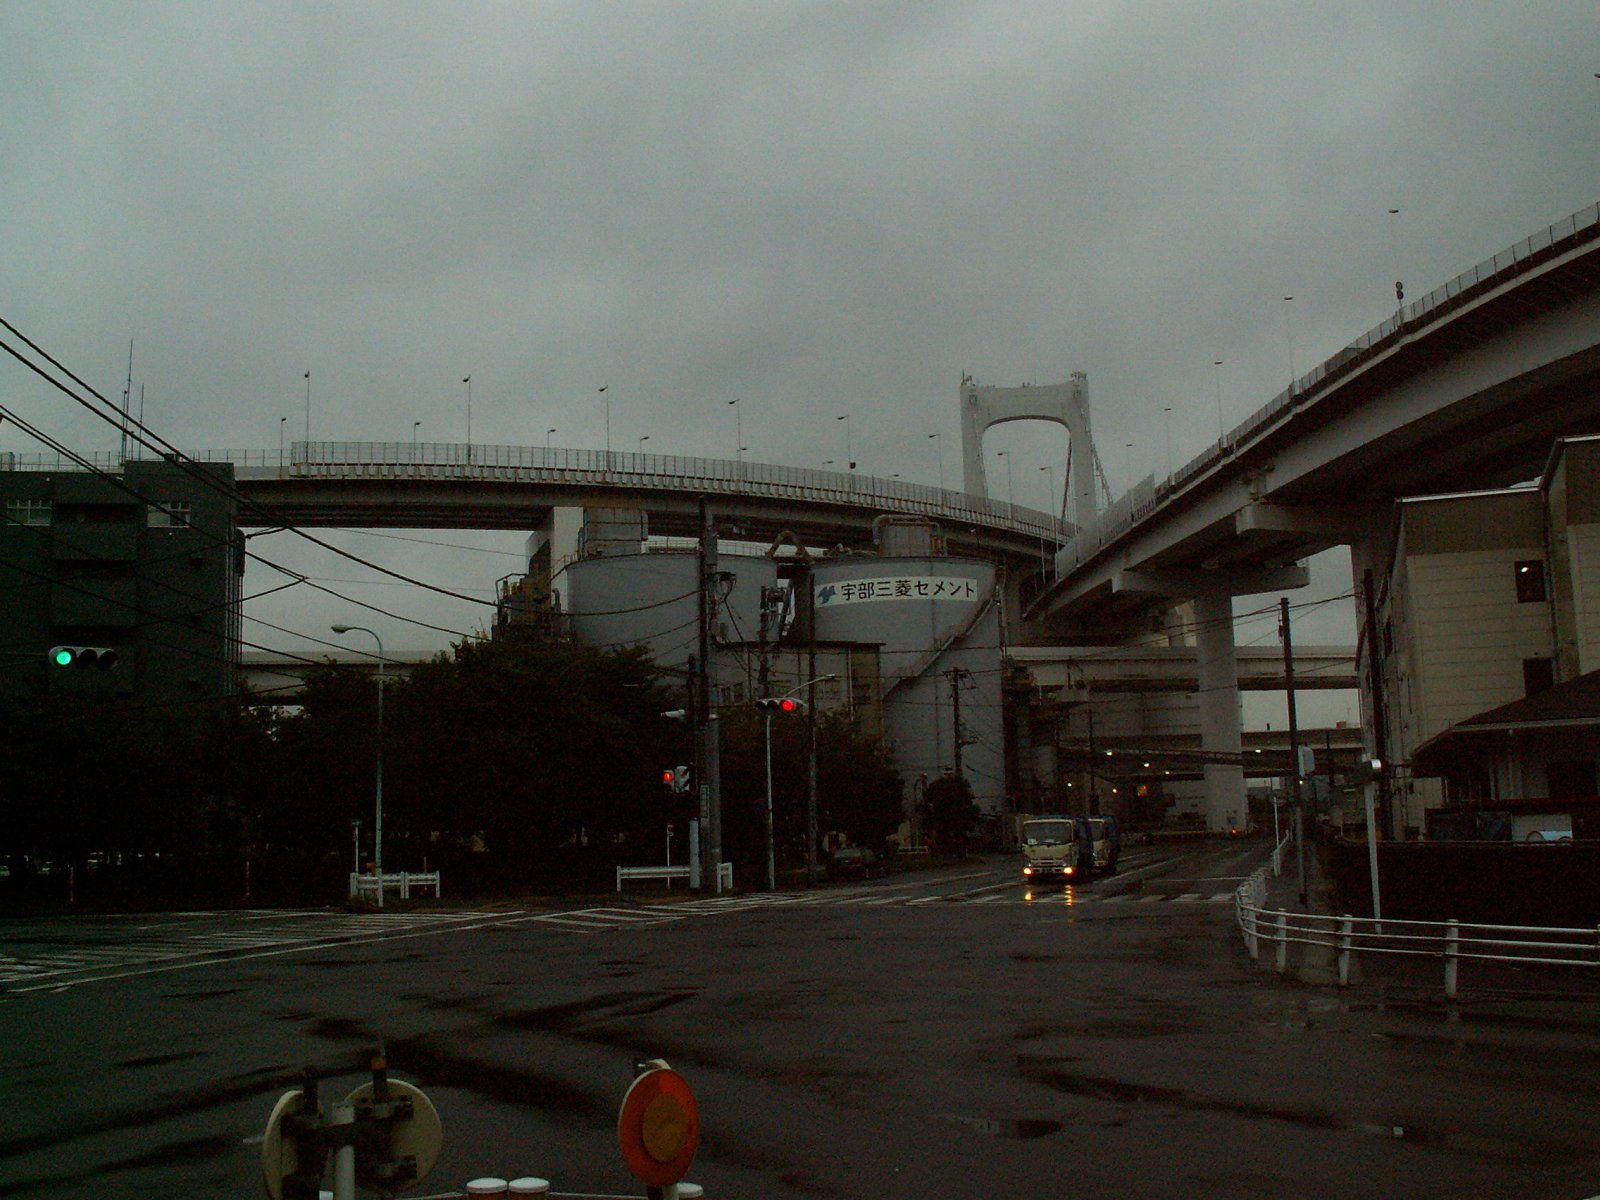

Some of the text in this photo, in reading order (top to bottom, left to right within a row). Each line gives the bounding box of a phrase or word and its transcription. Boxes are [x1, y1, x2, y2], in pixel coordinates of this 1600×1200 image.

[841, 580, 975, 601] 宇部三菱セメント
